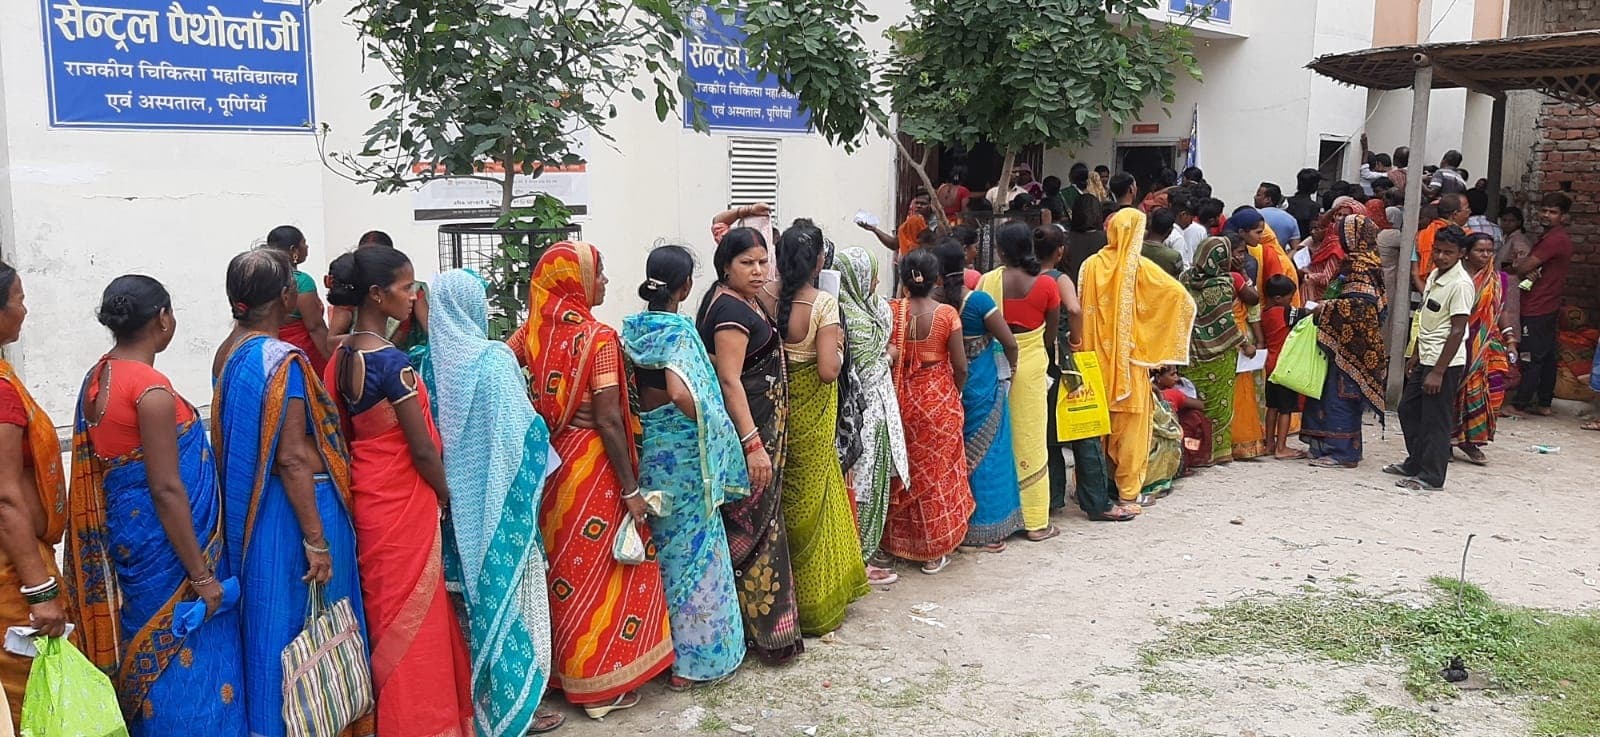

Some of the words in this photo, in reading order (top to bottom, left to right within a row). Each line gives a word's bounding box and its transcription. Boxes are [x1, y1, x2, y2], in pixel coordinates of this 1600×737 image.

[52, 0, 160, 52] सेन्ट्रल
[166, 1, 301, 51] पैथोलॉजी
[63, 58, 133, 78] राजकीय
[138, 60, 207, 82] चिकित्सा
[212, 65, 298, 86] महाविद्यालय
[694, 80, 727, 95] ाजकीय
[729, 81, 763, 97] चिकित्सा
[105, 90, 132, 112] एवं
[138, 94, 213, 114] अस्पताल,
[712, 103, 725, 119] एवं
[727, 106, 765, 120] अस्पताल,
